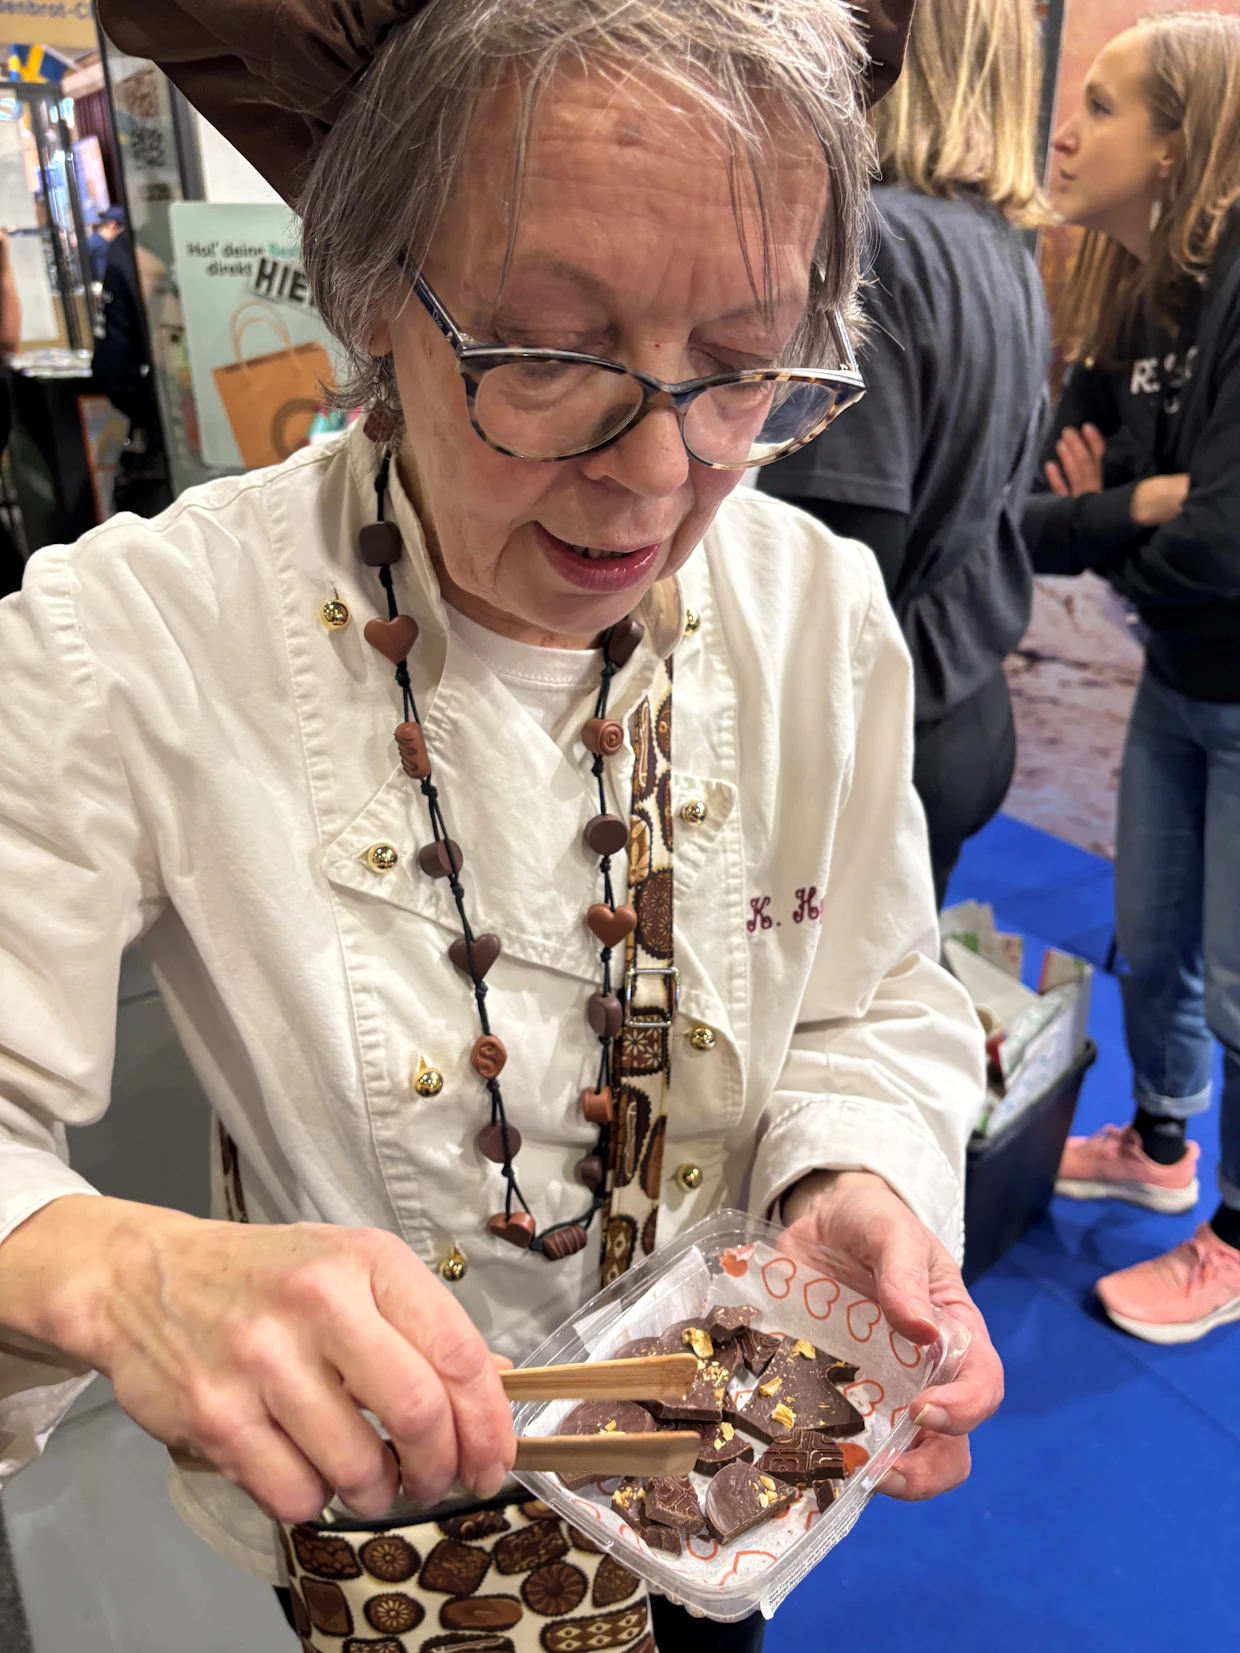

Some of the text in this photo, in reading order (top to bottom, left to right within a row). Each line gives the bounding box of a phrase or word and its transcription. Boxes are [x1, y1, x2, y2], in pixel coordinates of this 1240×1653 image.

[206, 257, 313, 307] direkt HIE
[747, 886, 825, 933] K. H
